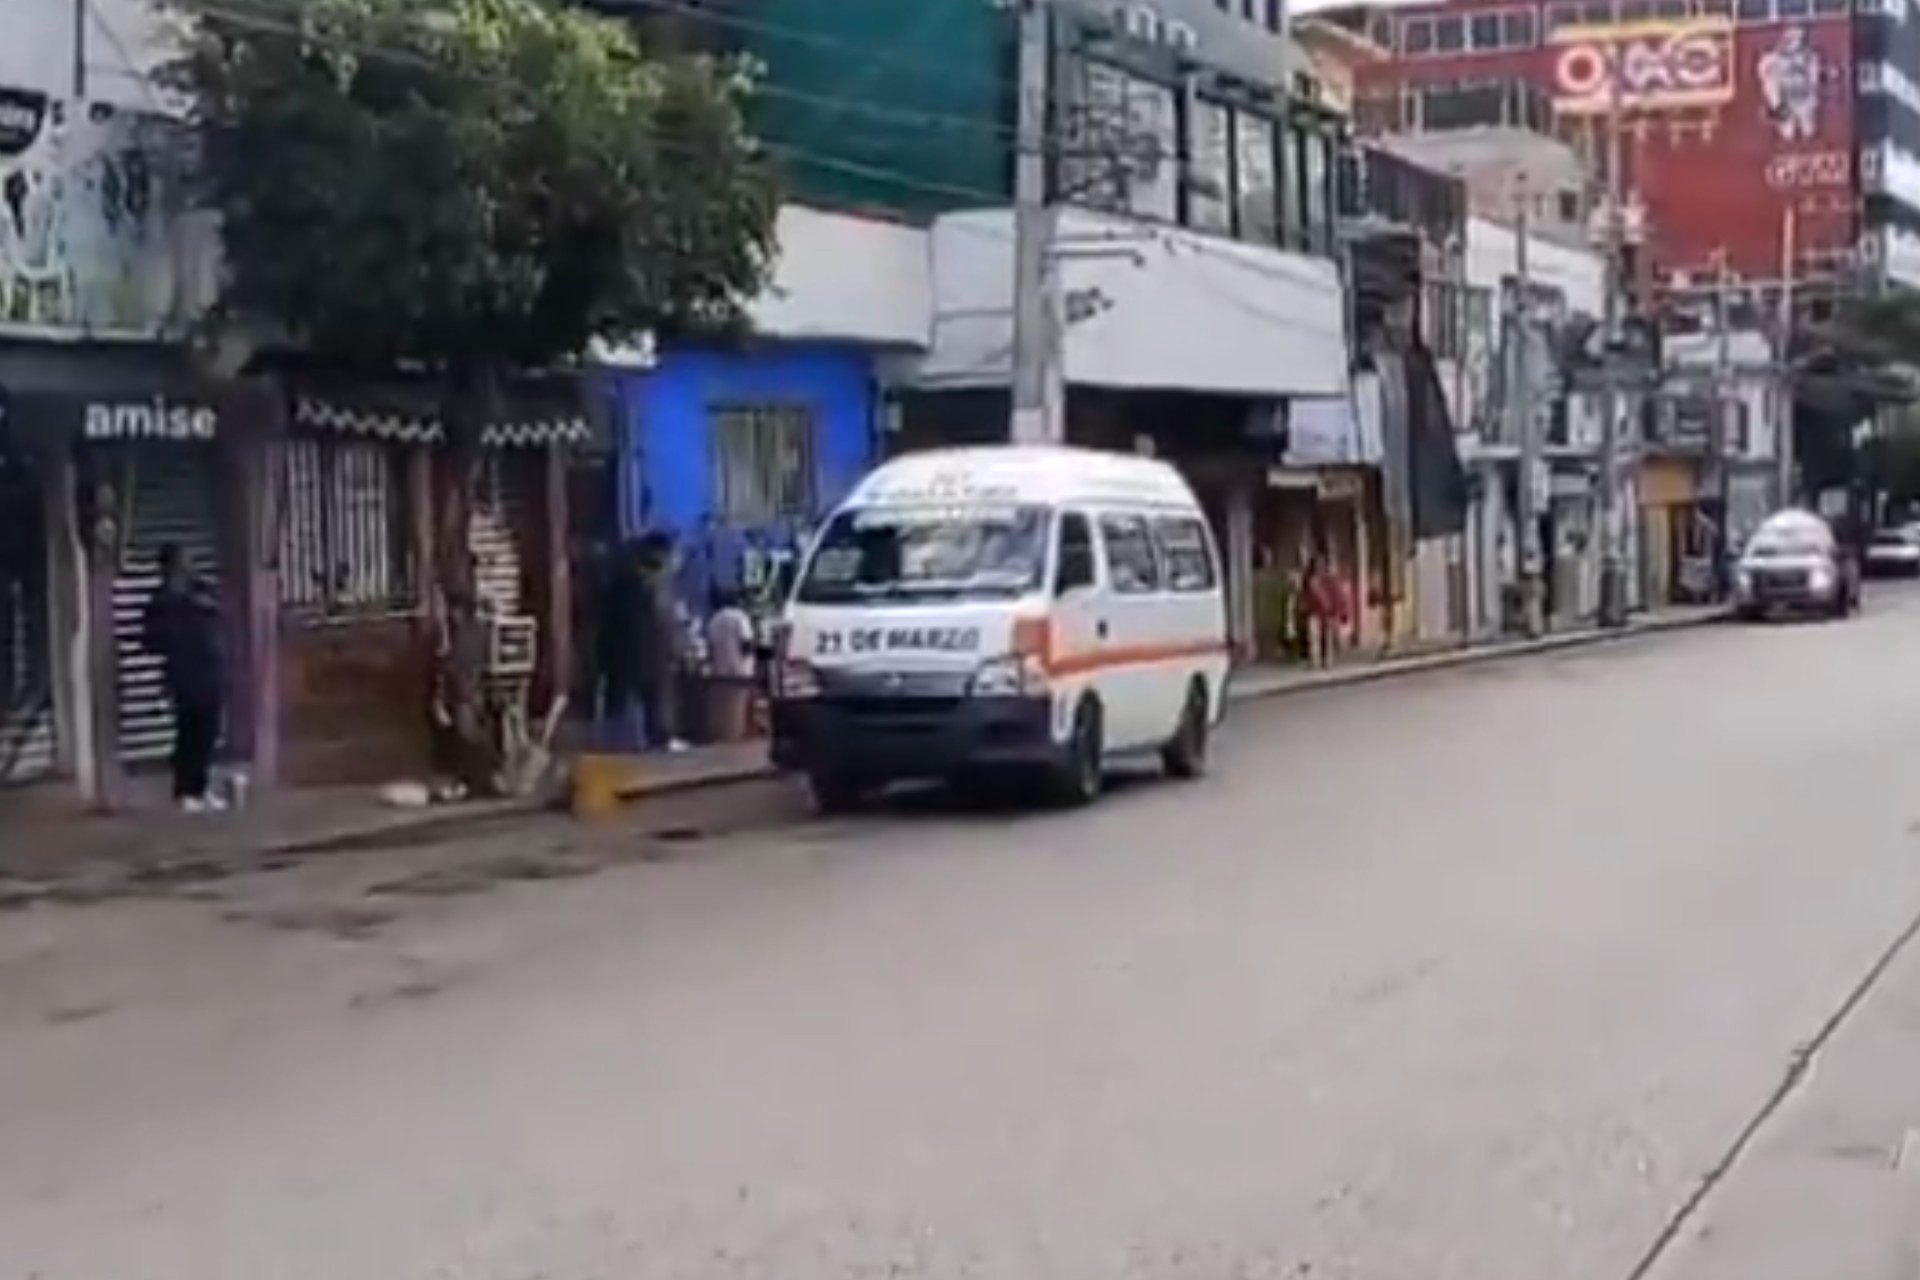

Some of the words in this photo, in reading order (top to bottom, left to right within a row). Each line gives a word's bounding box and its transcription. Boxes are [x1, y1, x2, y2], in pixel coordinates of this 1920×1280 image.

[816, 631, 842, 653] 21
[849, 628, 883, 651] DE
[887, 626, 980, 650] MARZO
